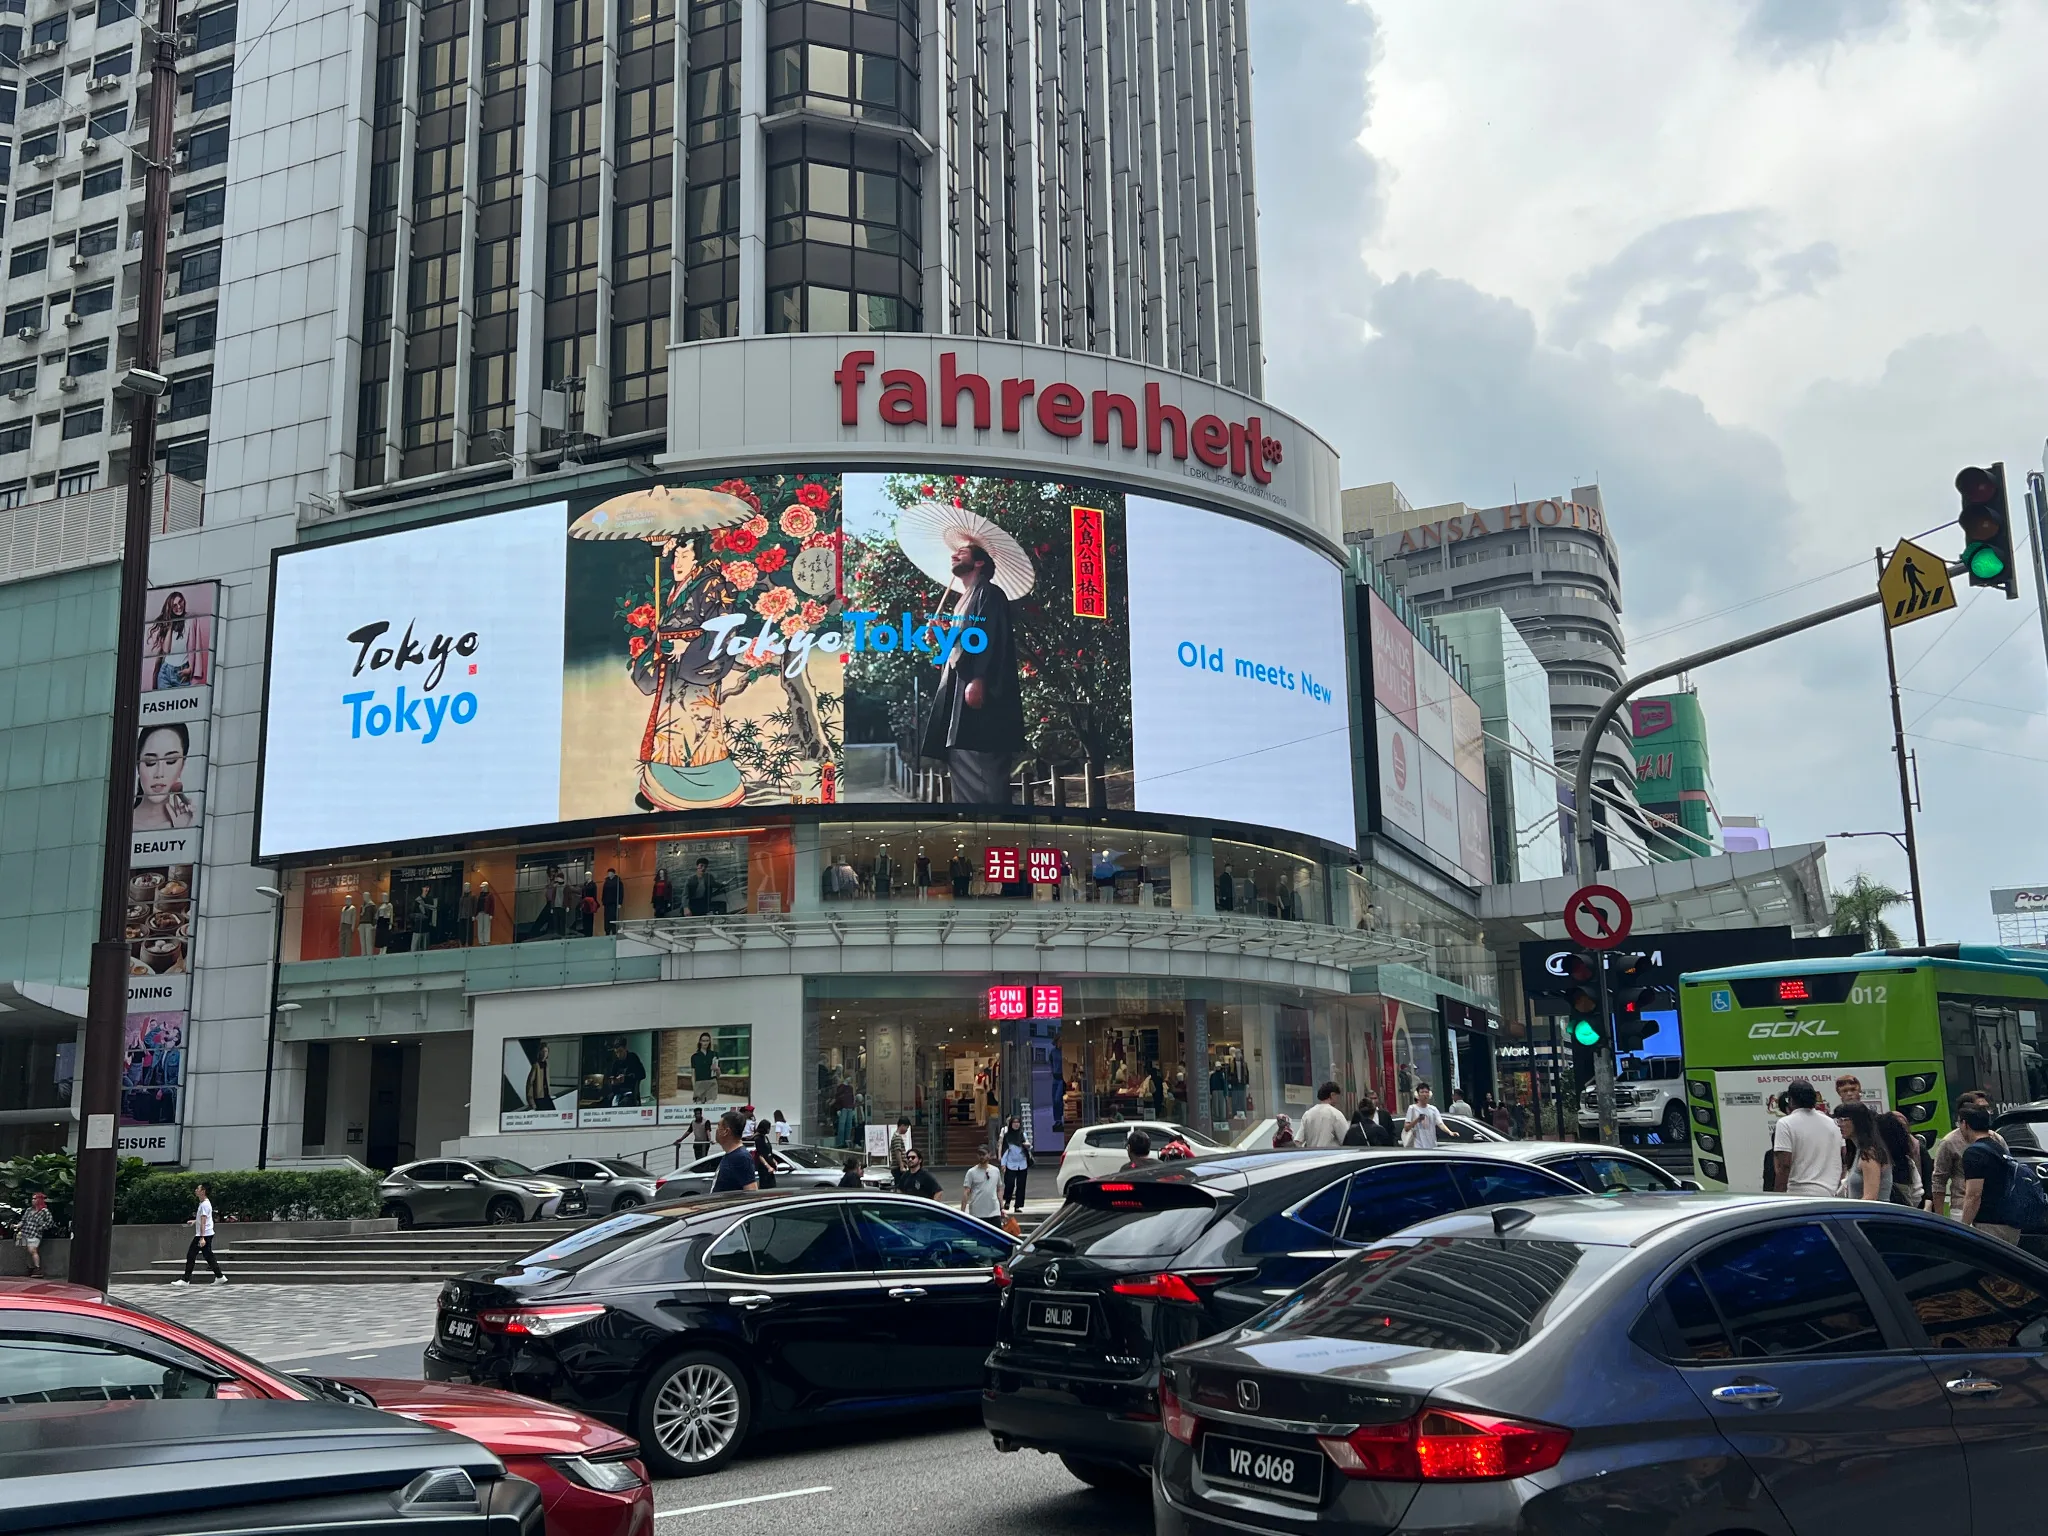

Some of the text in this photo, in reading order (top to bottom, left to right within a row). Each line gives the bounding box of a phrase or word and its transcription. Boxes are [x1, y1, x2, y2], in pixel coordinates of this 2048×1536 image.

[1400, 499, 1609, 554] ANSA HOTEL
[968, 614, 987, 622] New
[700, 613, 843, 678] Tokyo
[842, 611, 989, 665] Tokyo
[1374, 616, 1411, 677] BRANDS
[346, 616, 480, 693] Tokyo
[1177, 641, 1332, 705] Old meets New
[1376, 652, 1411, 708] OUTLET
[142, 698, 199, 714] FASHION
[342, 685, 478, 744] Tokyo
[1640, 710, 1664, 726] yes
[1636, 752, 1674, 782] H&M
[133, 840, 186, 854] BEAUTY
[989, 851, 1015, 864] ユニ
[1030, 852, 1055, 866] UNI
[988, 866, 1016, 879] クロ
[1031, 867, 1058, 882] QLO
[311, 874, 360, 888] HEATECH
[127, 986, 173, 999] DINING
[999, 989, 1021, 1001] UNI
[1036, 989, 1059, 1001] ユニ
[1851, 986, 1887, 1005] 012
[1000, 1002, 1023, 1016] QLO
[1036, 1002, 1059, 1014] クロ
[1748, 1020, 1840, 1038] GOKL
[1752, 1050, 1839, 1061] www.dbkl.gov.my
[1757, 1074, 1832, 1084] BAS PERCUMA OLEH
[117, 1137, 166, 1150] EISURE
[1045, 1307, 1073, 1325] BNL 118
[1229, 1447, 1295, 1484] VR 6168
